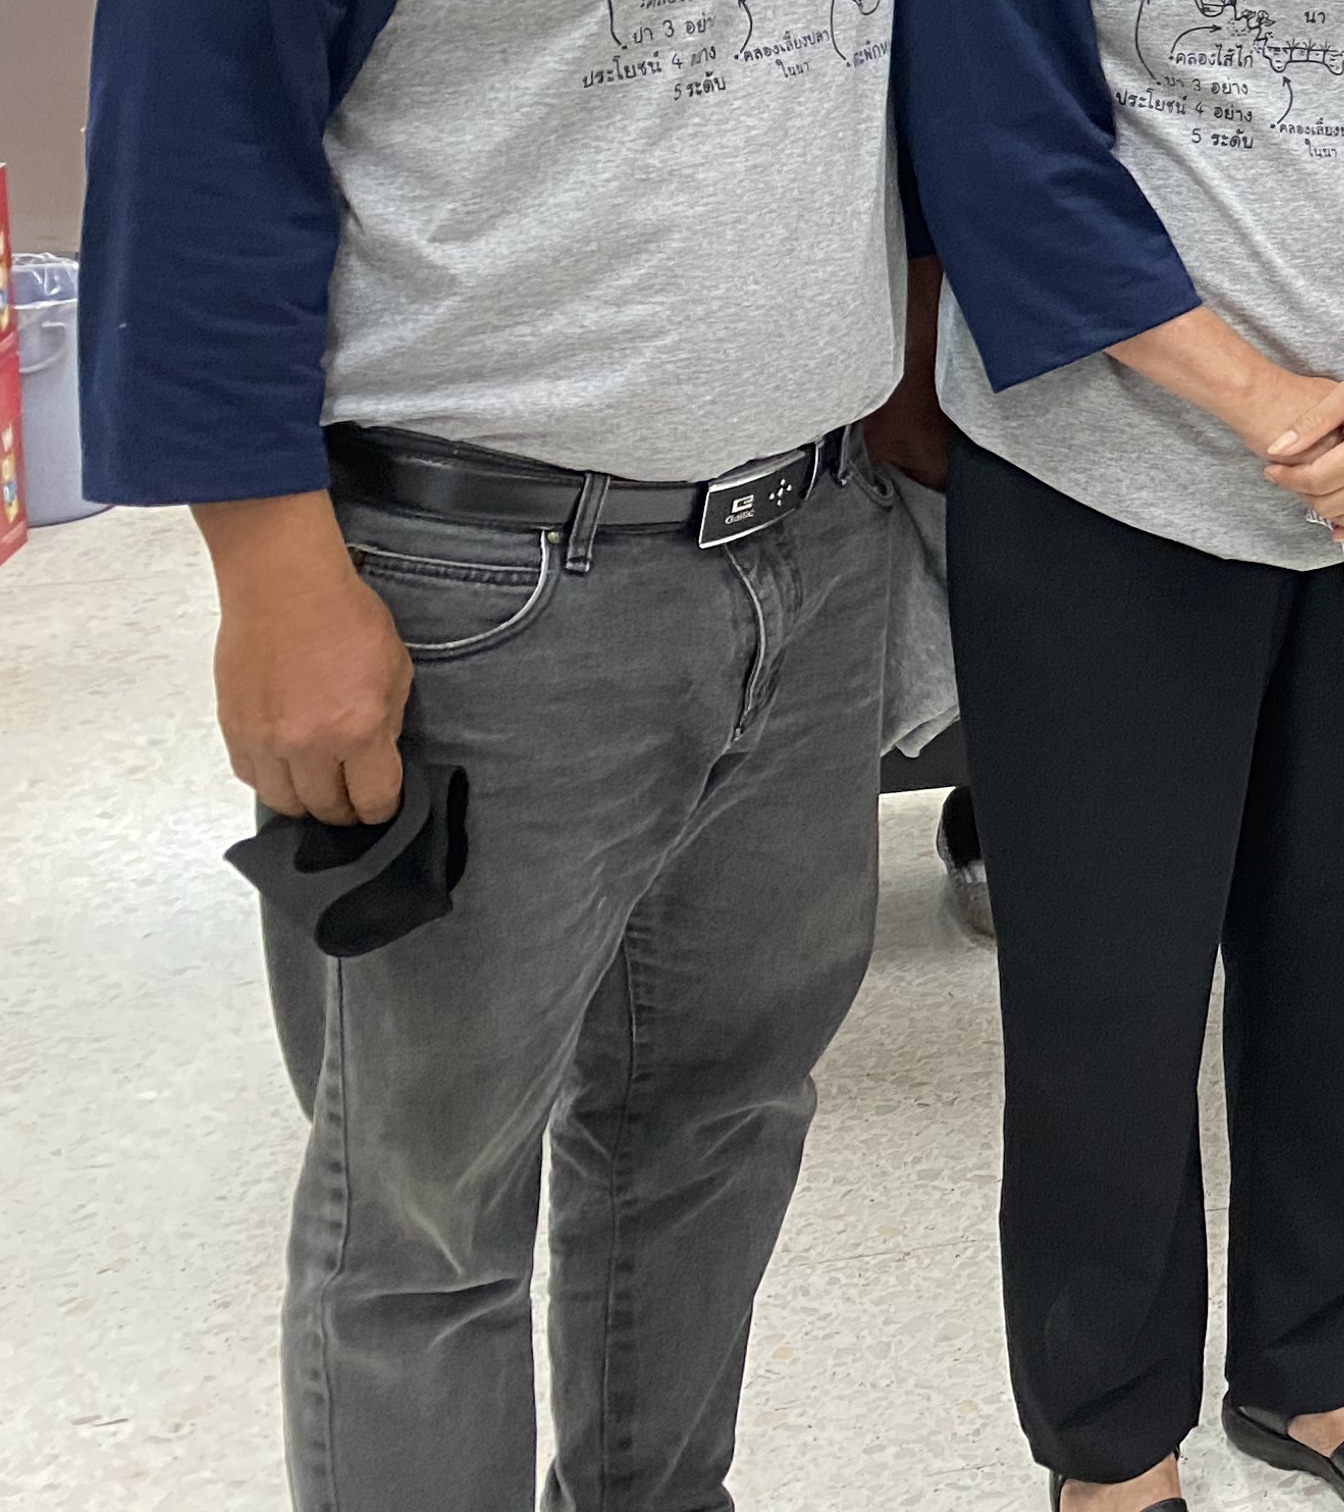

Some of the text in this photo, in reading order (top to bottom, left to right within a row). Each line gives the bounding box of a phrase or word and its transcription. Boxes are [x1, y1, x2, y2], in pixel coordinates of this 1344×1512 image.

[1304, 10, 1327, 25] นา
[663, 19, 676, 39] 3
[671, 52, 684, 70] 4
[1192, 78, 1202, 92] 3
[1194, 100, 1205, 114] 4
[1191, 127, 1203, 144] 5
